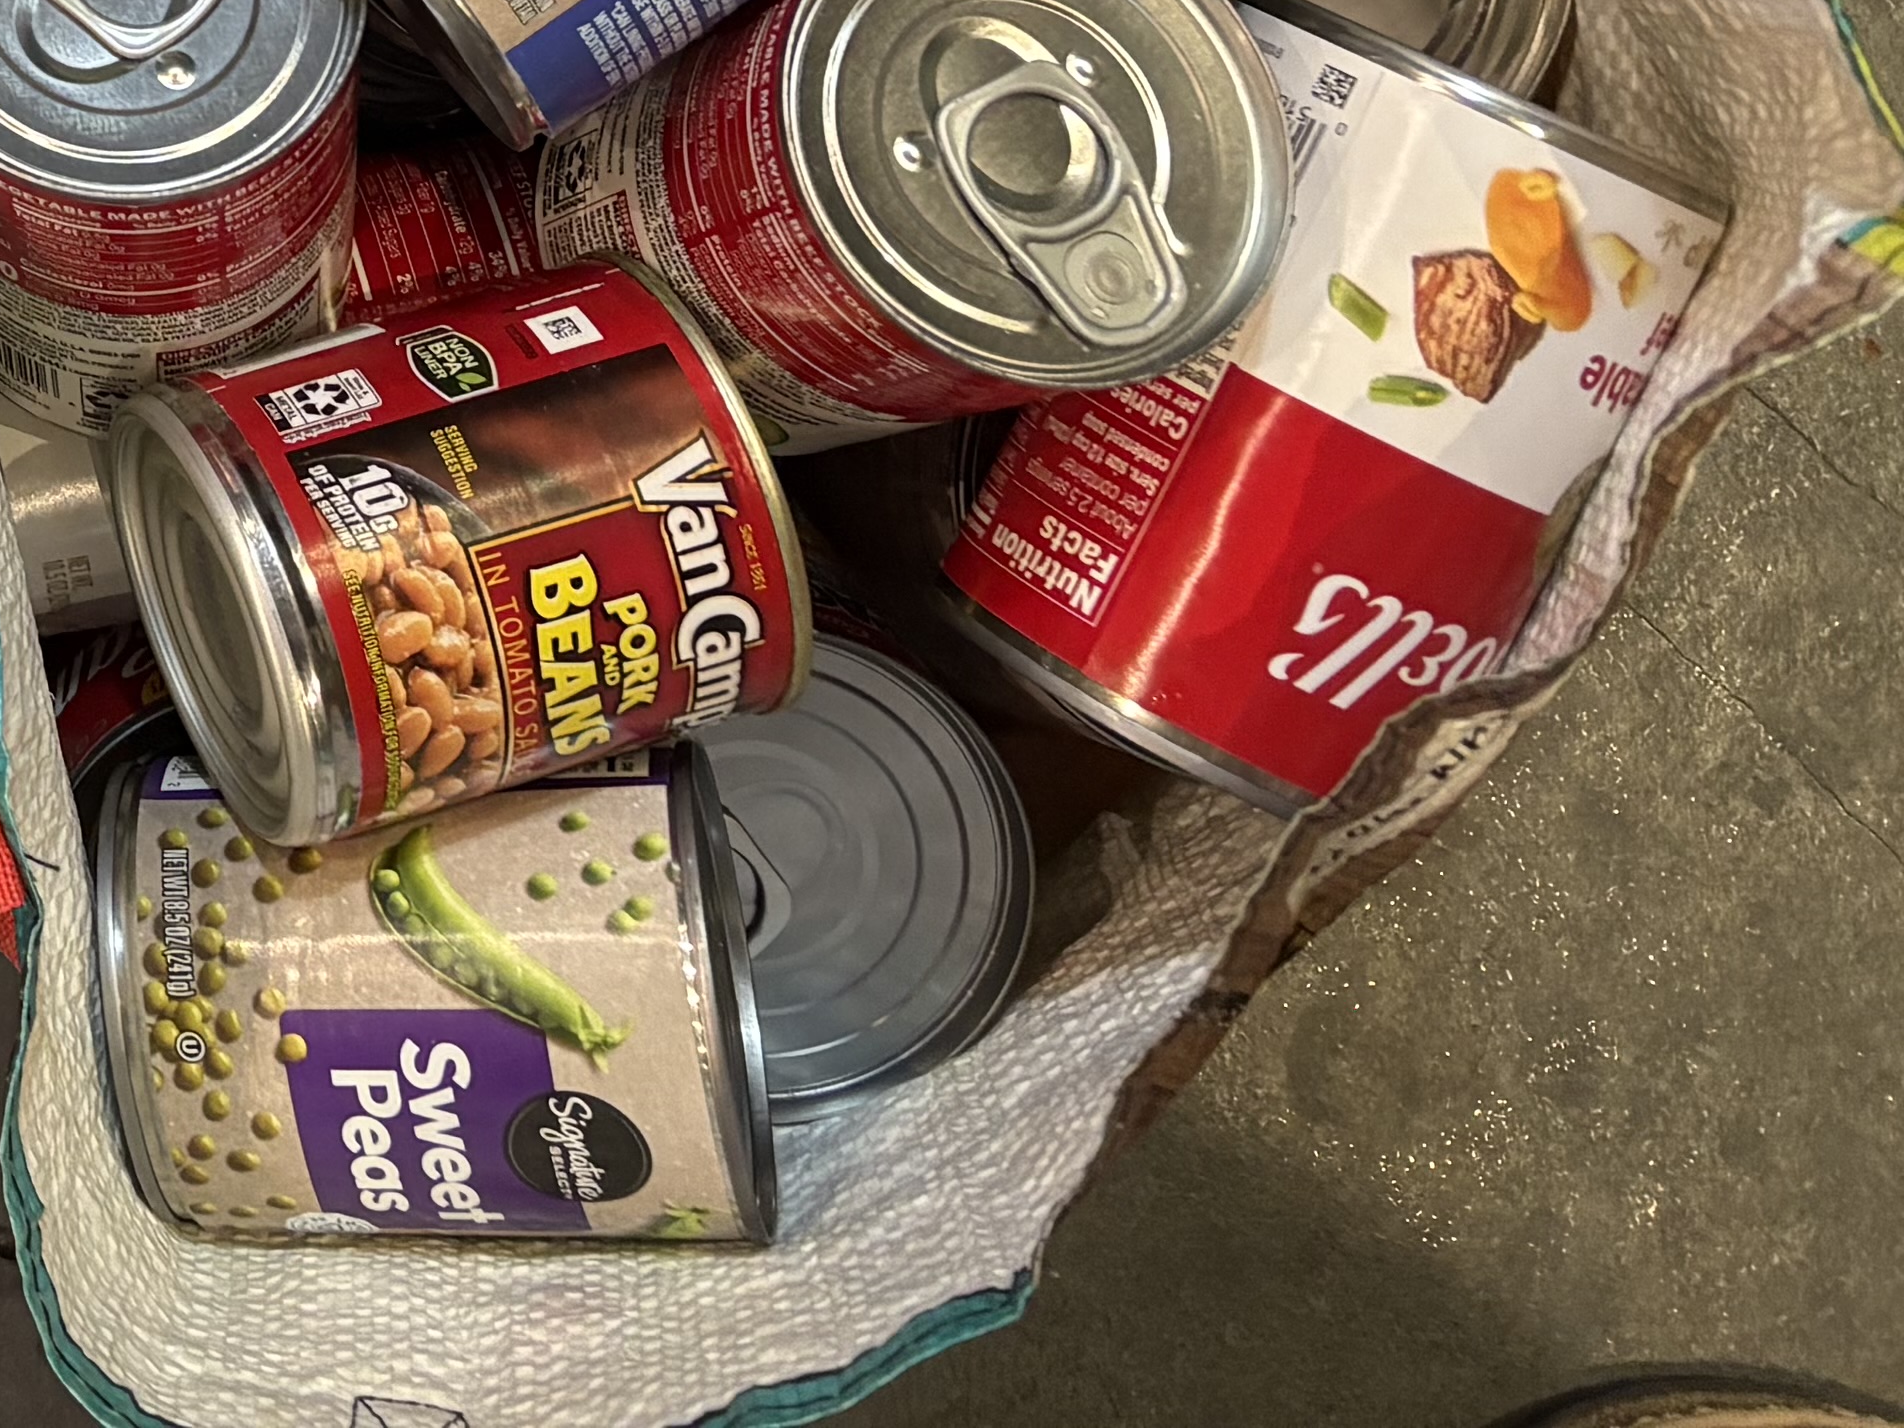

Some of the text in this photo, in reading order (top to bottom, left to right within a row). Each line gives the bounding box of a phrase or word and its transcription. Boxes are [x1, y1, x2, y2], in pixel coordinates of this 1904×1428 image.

[414, 346, 448, 381] LINER
[430, 341, 464, 375] BPA
[446, 336, 477, 369] NON
[430, 428, 474, 500] SUGGESTION
[991, 515, 1120, 616] Nutrition Facts
[478, 550, 537, 715] IN TOMATO
[529, 553, 616, 756] BEANS
[600, 592, 660, 714] PORK AND
[330, 1068, 410, 1214] Peas
[399, 1037, 505, 1225] Sweet
[540, 1095, 603, 1202] Signature
